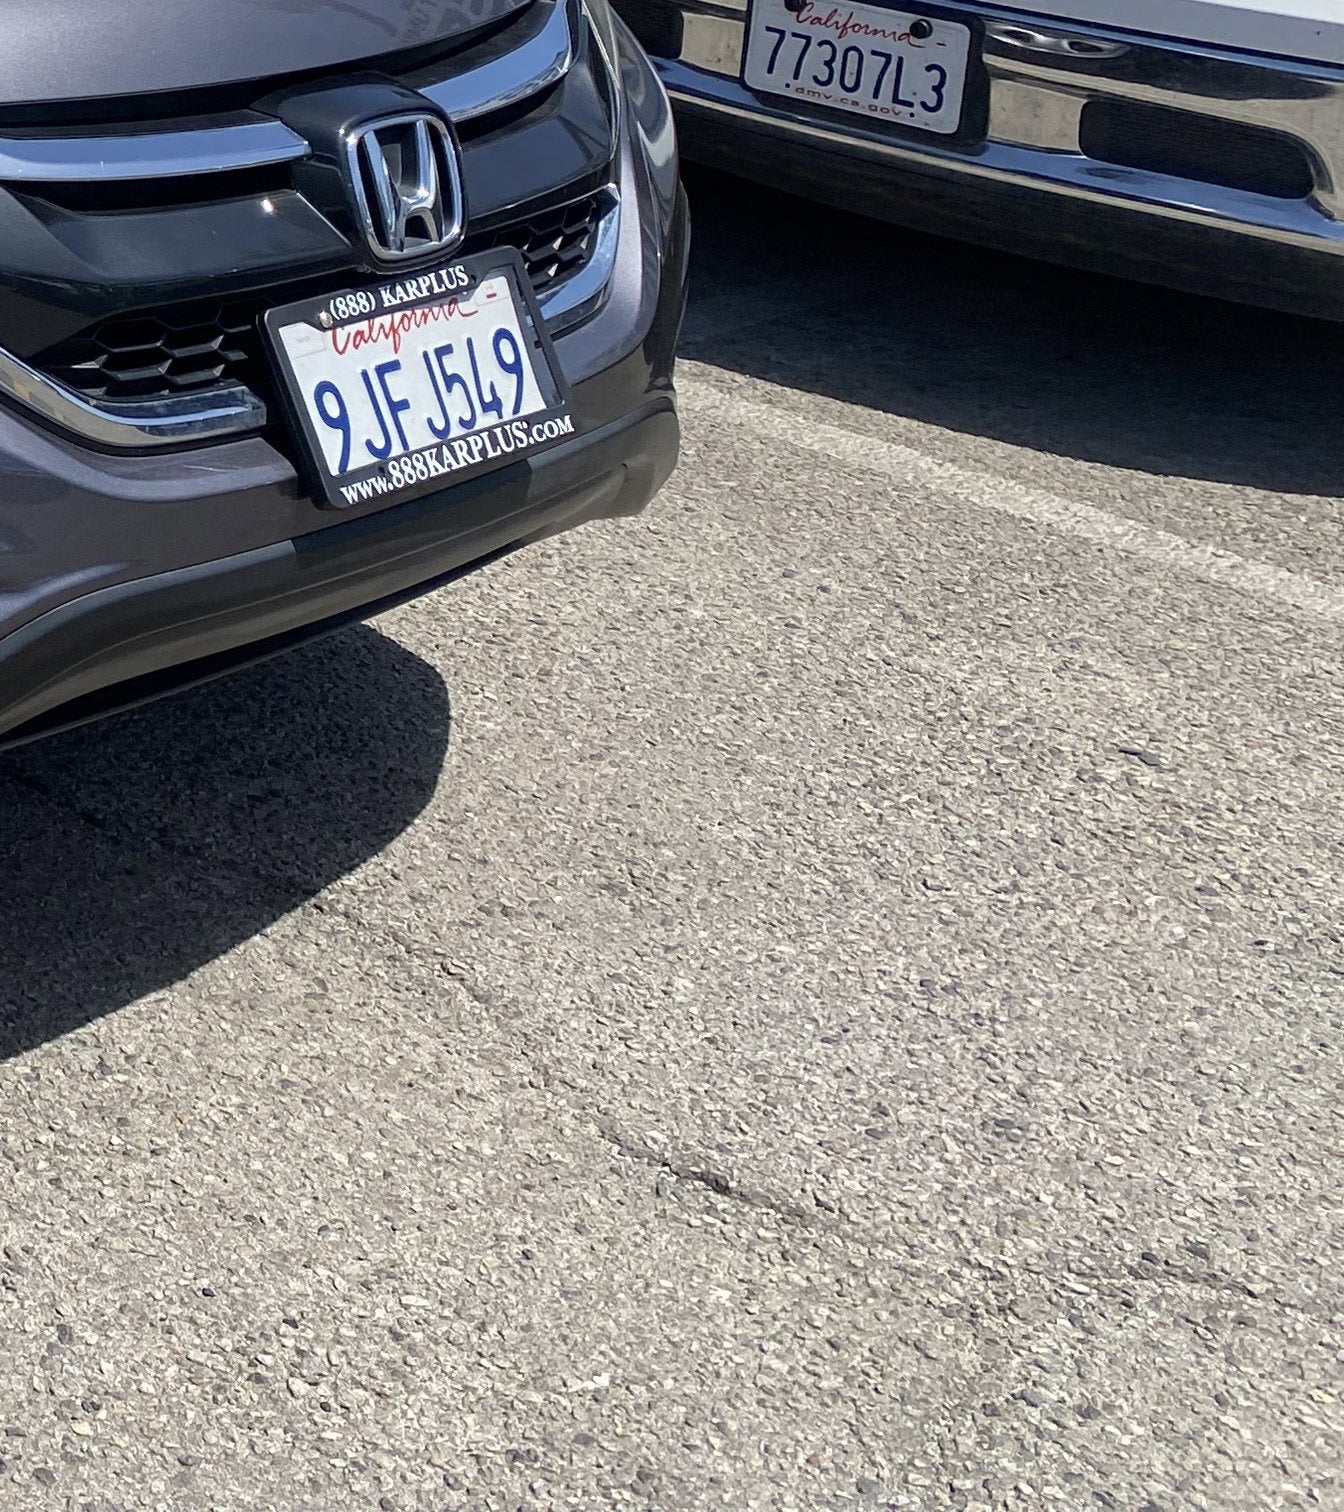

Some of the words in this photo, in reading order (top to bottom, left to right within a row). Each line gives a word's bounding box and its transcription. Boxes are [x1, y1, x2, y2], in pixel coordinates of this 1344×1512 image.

[796, 1, 925, 48] California
[765, 25, 947, 113] 77307L3
[795, 86, 902, 117] dmv.ca.gov
[330, 293, 376, 321] (888)
[382, 265, 469, 308] KARPLUS
[331, 299, 478, 356] California
[313, 327, 525, 474] 9JFJ549
